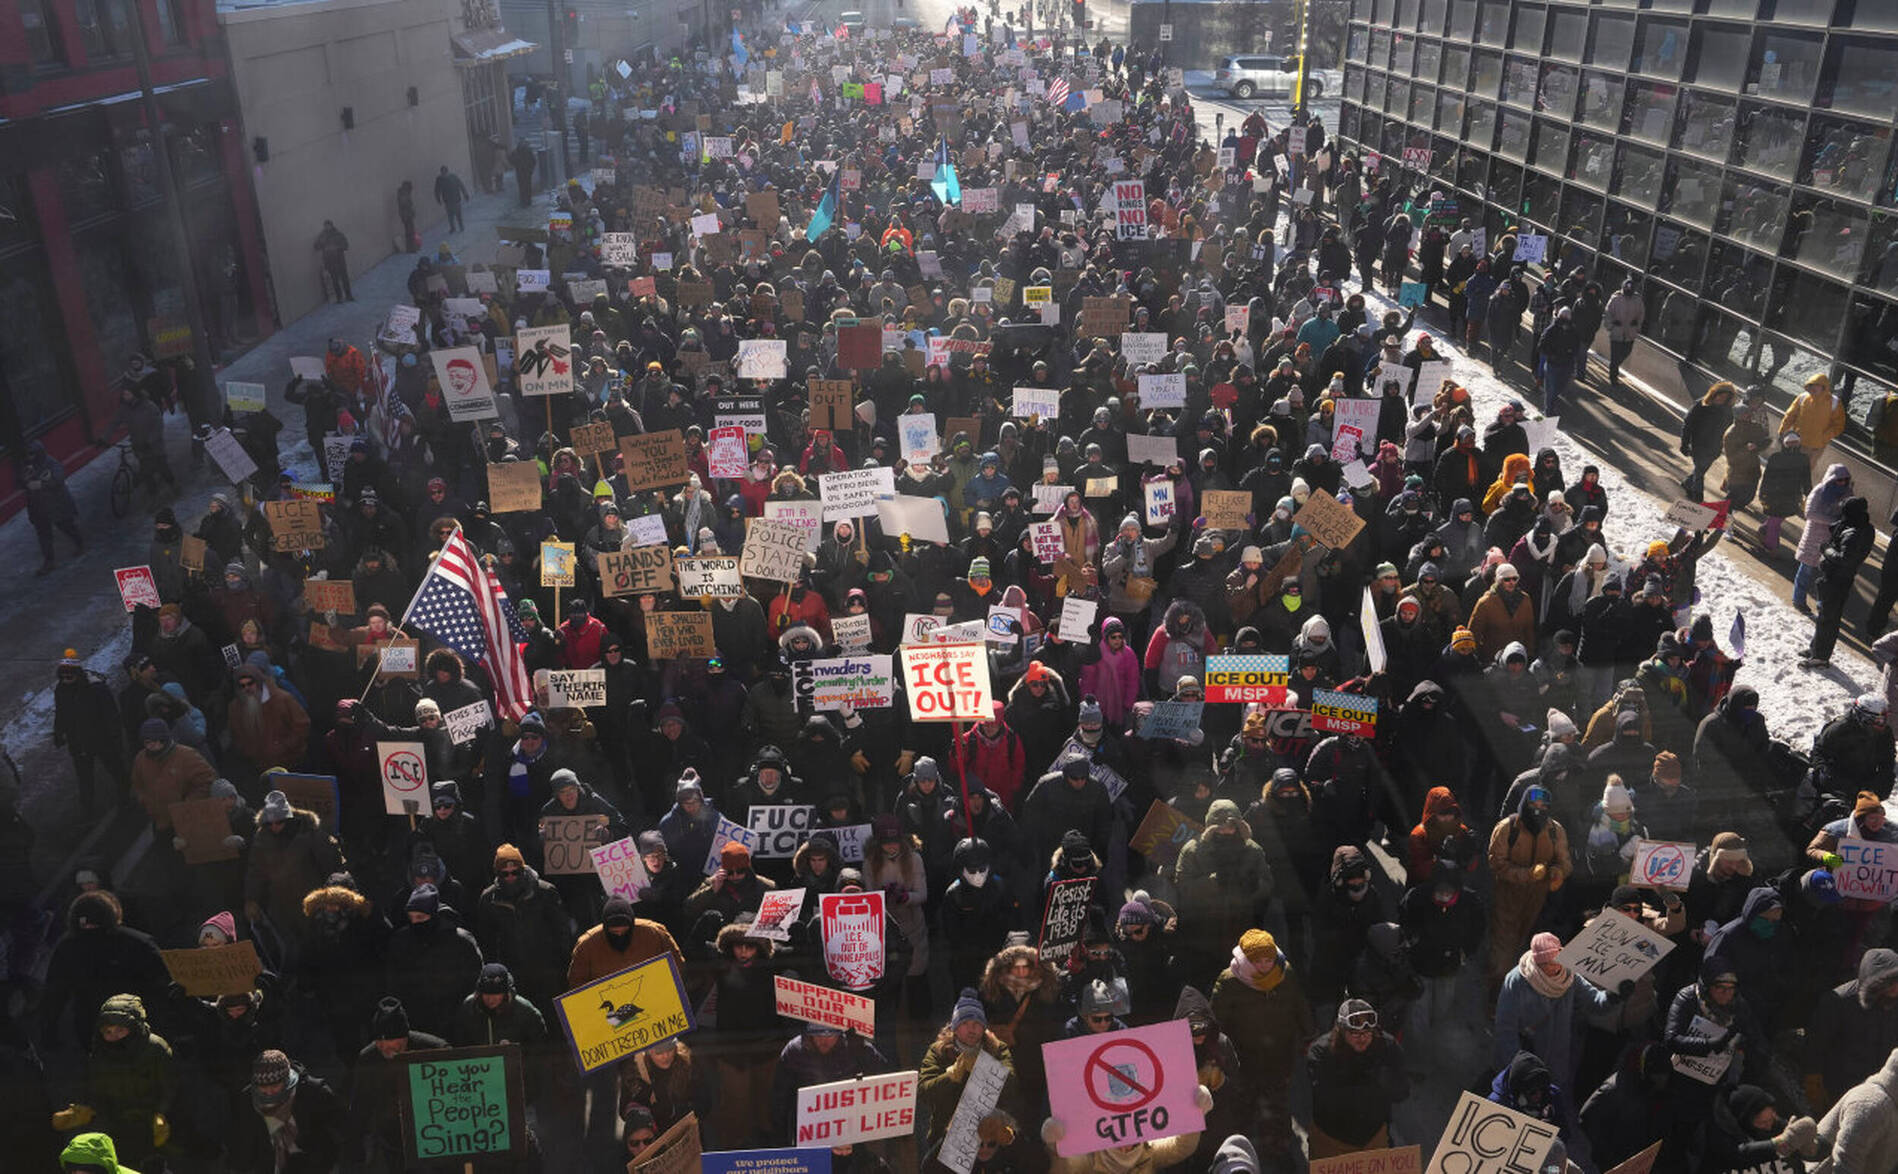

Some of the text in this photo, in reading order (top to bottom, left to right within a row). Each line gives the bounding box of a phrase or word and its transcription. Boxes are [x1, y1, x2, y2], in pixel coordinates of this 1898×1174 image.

[1116, 184, 1143, 200] NO
[1119, 209, 1145, 224] NO
[1120, 224, 1145, 237] ICE
[944, 339, 992, 354] MURDER
[525, 380, 569, 392] ON MN
[816, 381, 843, 391] ICE
[718, 400, 760, 410] OUT HERE
[815, 394, 844, 405] OUT
[642, 446, 667, 458] YOU
[825, 471, 873, 482] OPERATION
[826, 481, 851, 492] METRO
[843, 489, 874, 500] SAFETY
[1153, 488, 1167, 501] MN
[274, 502, 313, 518] ICE
[750, 527, 805, 551] POLICE
[606, 551, 665, 573] HANDS
[678, 561, 735, 572] THE WORLD
[743, 544, 801, 570] STATE
[614, 570, 656, 590] OFF
[702, 573, 714, 583] IS
[683, 584, 742, 596] WATCHING
[909, 650, 958, 661] NEIGHBORS
[551, 673, 575, 684] SAY
[912, 661, 975, 688] ICE
[1208, 672, 1286, 685] ICE OUT
[566, 692, 603, 701] NAME
[843, 696, 889, 708] TRUMP
[916, 691, 981, 713] OUT!
[1225, 687, 1268, 699] MSP
[447, 703, 485, 722] THIS IS
[1313, 704, 1375, 722] ICE OUT
[1265, 711, 1312, 738] ICE
[1327, 718, 1360, 731] MSP
[389, 760, 422, 781] ICE
[548, 819, 599, 842] ICE
[717, 820, 752, 848] ICE
[833, 828, 859, 842] UCK
[551, 844, 597, 870] OUT
[594, 839, 635, 866] ICE
[843, 846, 859, 857] CE
[1840, 845, 1884, 865] ICE
[600, 856, 635, 878] OUT
[1649, 856, 1682, 878] ICE
[1857, 866, 1898, 884] OUT
[613, 869, 632, 886] OF
[1052, 882, 1092, 904] Resist
[1047, 904, 1070, 926] Like
[1049, 921, 1076, 940] 1938
[1597, 918, 1637, 946] PLOW
[840, 942, 869, 952] OUT OF
[1587, 937, 1646, 970] ICE OUT
[830, 952, 880, 963] MINNEAPOLIS
[1576, 955, 1617, 976] MN
[775, 978, 870, 1009] SUPPORT
[803, 995, 845, 1016] OUR
[652, 1021, 668, 1039] ON
[667, 1013, 688, 1032] ME
[776, 1001, 874, 1036] NEIGHBORS
[421, 1063, 490, 1083] Do you
[432, 1079, 484, 1098] Hear
[807, 1080, 913, 1113] JUSTICE
[428, 1098, 500, 1129] People
[799, 1107, 914, 1142] NOT LIES
[1096, 1105, 1169, 1143] GTFO
[421, 1120, 505, 1155] Sing?
[1451, 1101, 1552, 1174] ICE
[735, 1157, 798, 1168] We protect
[1318, 1153, 1415, 1174] SHAME ON YOU
